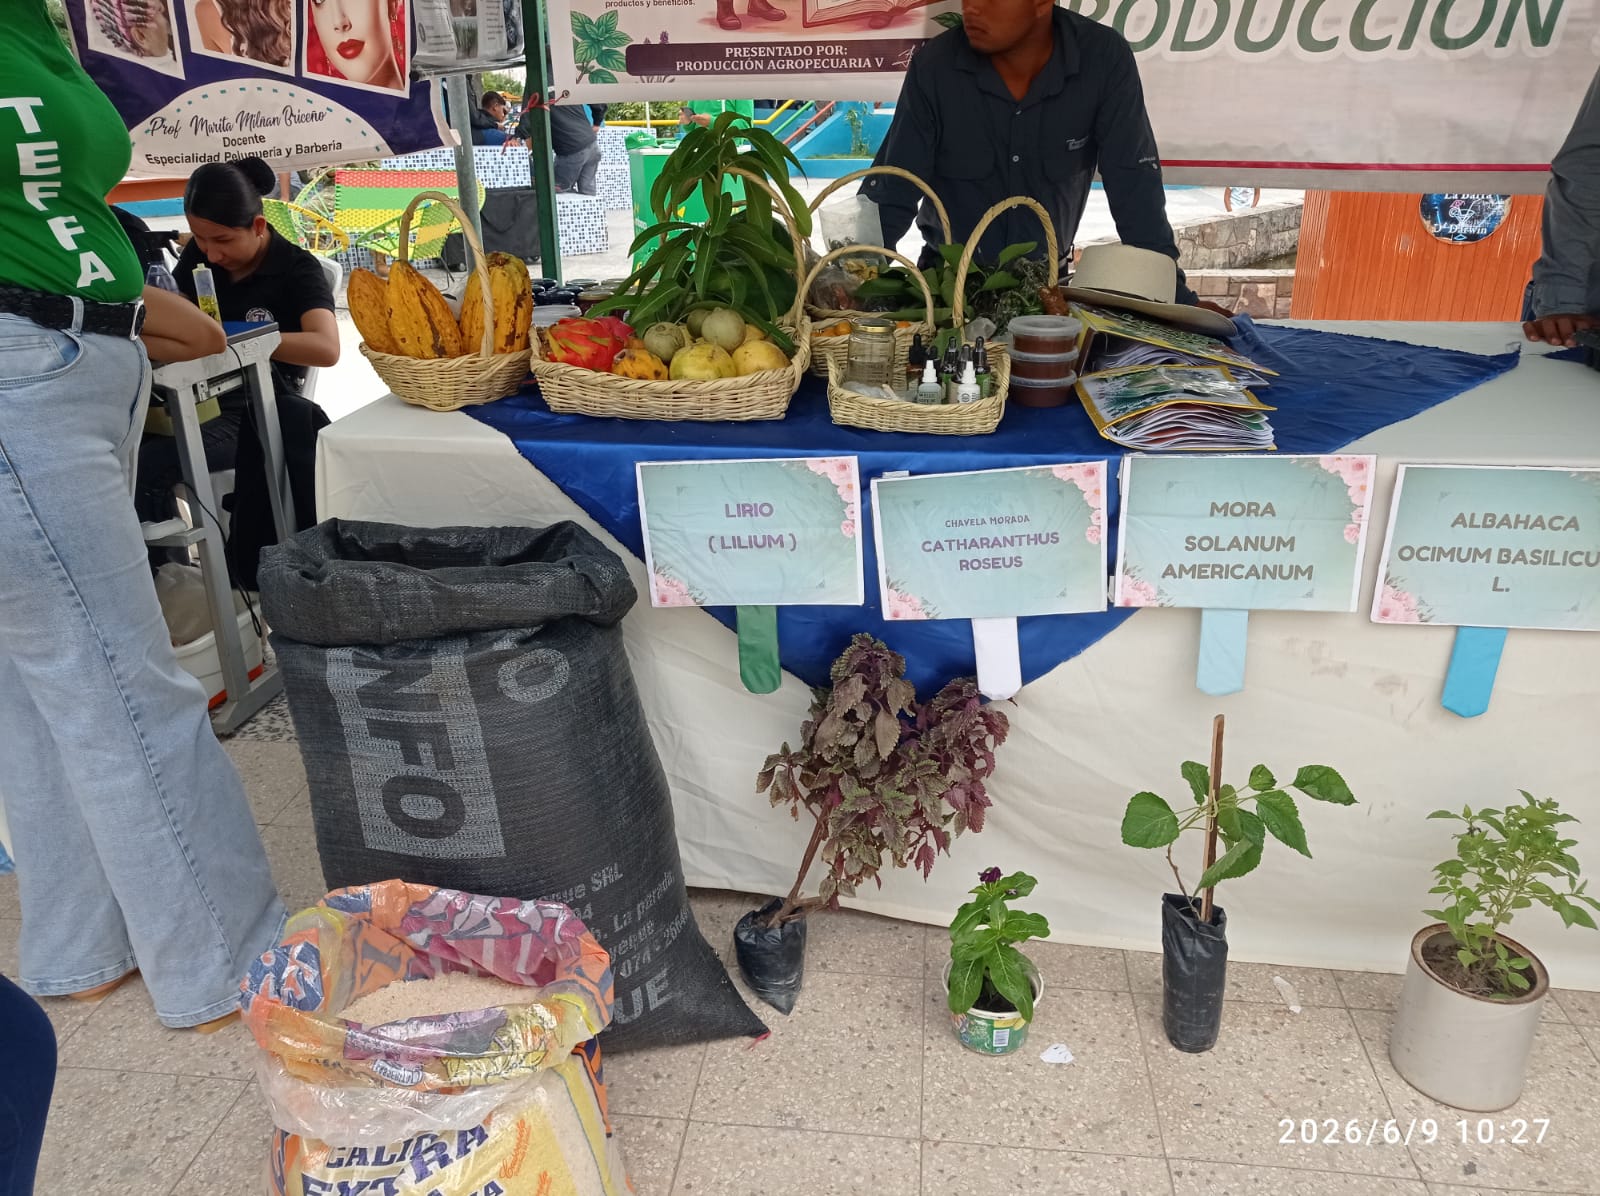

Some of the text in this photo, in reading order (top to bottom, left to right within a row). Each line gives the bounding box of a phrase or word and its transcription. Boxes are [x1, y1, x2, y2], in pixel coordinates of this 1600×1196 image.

[725, 45, 848, 58] PRESENTADO POR:
[676, 57, 884, 71] PRODUCCIÓN AGROPECUARIA V
[150, 116, 181, 139] Prof
[190, 114, 234, 136] Marita
[282, 105, 327, 127] Briceño
[222, 134, 266, 148] Docente
[145, 152, 220, 166] Especialidad
[285, 147, 292, 158] y
[725, 502, 774, 518] LIRIO
[1209, 501, 1276, 518] MORA
[945, 514, 1030, 528] CHAVELA MORADA
[1450, 512, 1580, 532] ALBAHACA
[720, 534, 785, 550] LILIUM
[921, 532, 1060, 553] CATHARANTHUS
[1184, 535, 1296, 552] SOLANUM
[959, 556, 1023, 571] ROSEUS
[1398, 545, 1600, 567] OCIMUM BASILICU
[1161, 563, 1314, 581] AMERICANUM
[1491, 576, 1510, 593] L.
